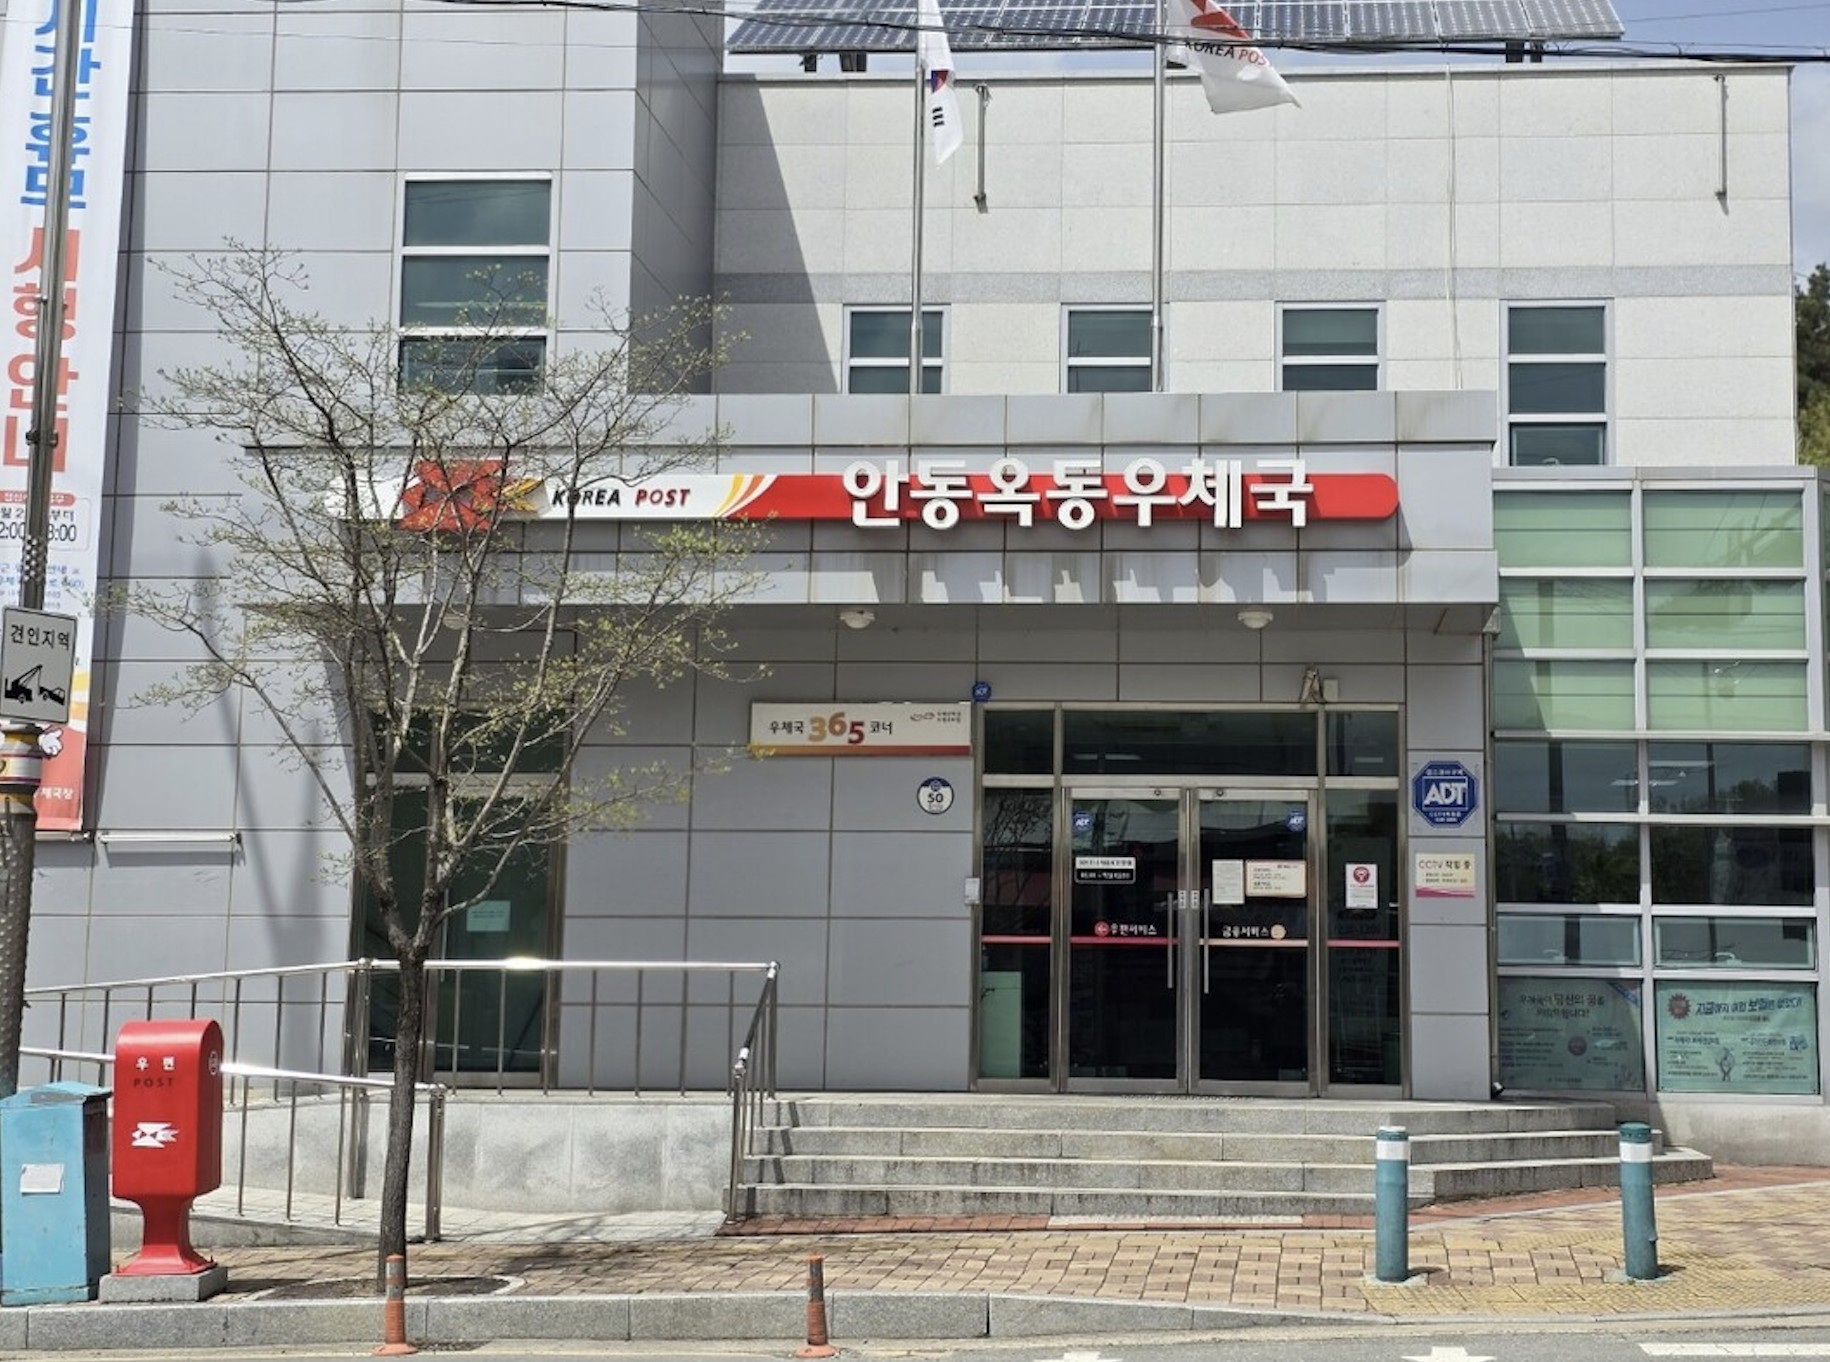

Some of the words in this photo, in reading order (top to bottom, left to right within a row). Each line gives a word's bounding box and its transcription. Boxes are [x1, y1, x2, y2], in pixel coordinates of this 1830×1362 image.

[635, 488, 691, 508] POST
[842, 457, 1314, 530] 안동옥동우체국
[11, 624, 70, 651] 견인지역
[770, 720, 804, 734] 우체국
[808, 711, 865, 744] 365
[870, 720, 893, 735] 코너
[927, 793, 944, 803] 50
[1423, 782, 1467, 805] ADT
[133, 1077, 176, 1088] POST
